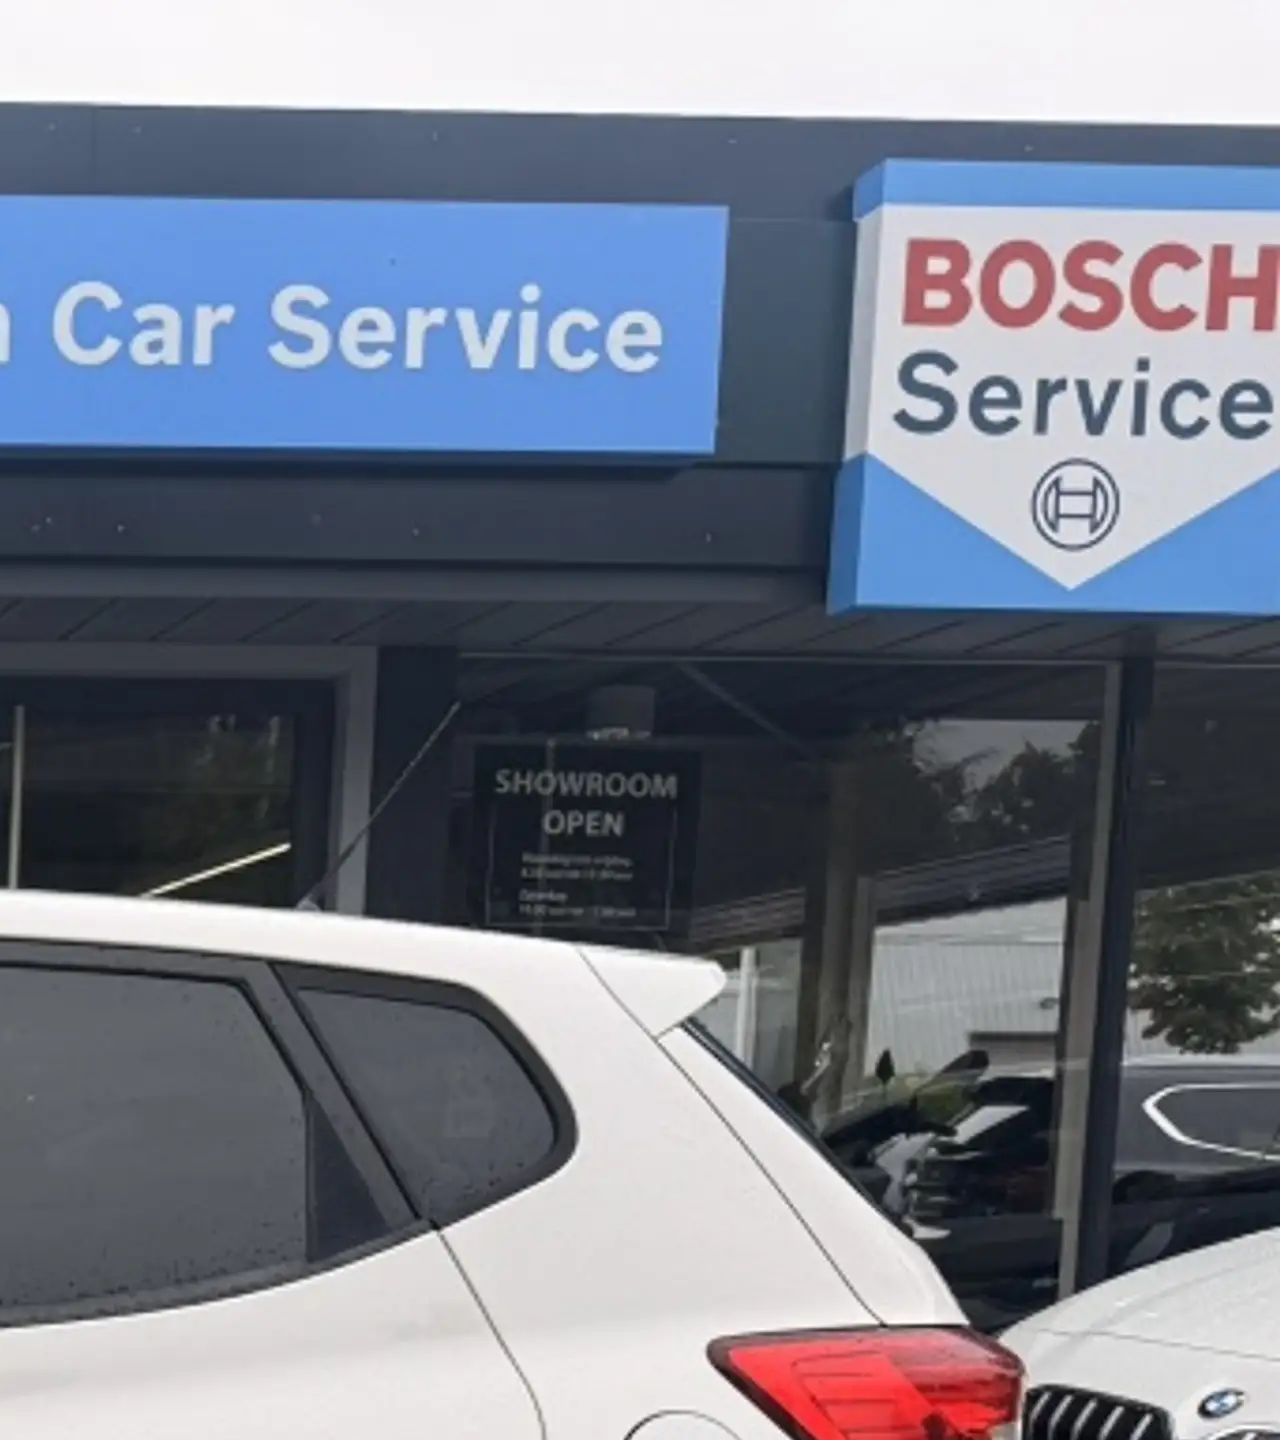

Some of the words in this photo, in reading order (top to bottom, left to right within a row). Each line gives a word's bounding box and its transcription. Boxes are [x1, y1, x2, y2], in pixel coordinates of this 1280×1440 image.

[51, 280, 236, 368] Car
[267, 283, 663, 374] Service
[902, 237, 1280, 332] BOSCH
[893, 350, 1274, 440] Service
[495, 769, 677, 798] SHOWROOM
[543, 810, 624, 836] OPEN
